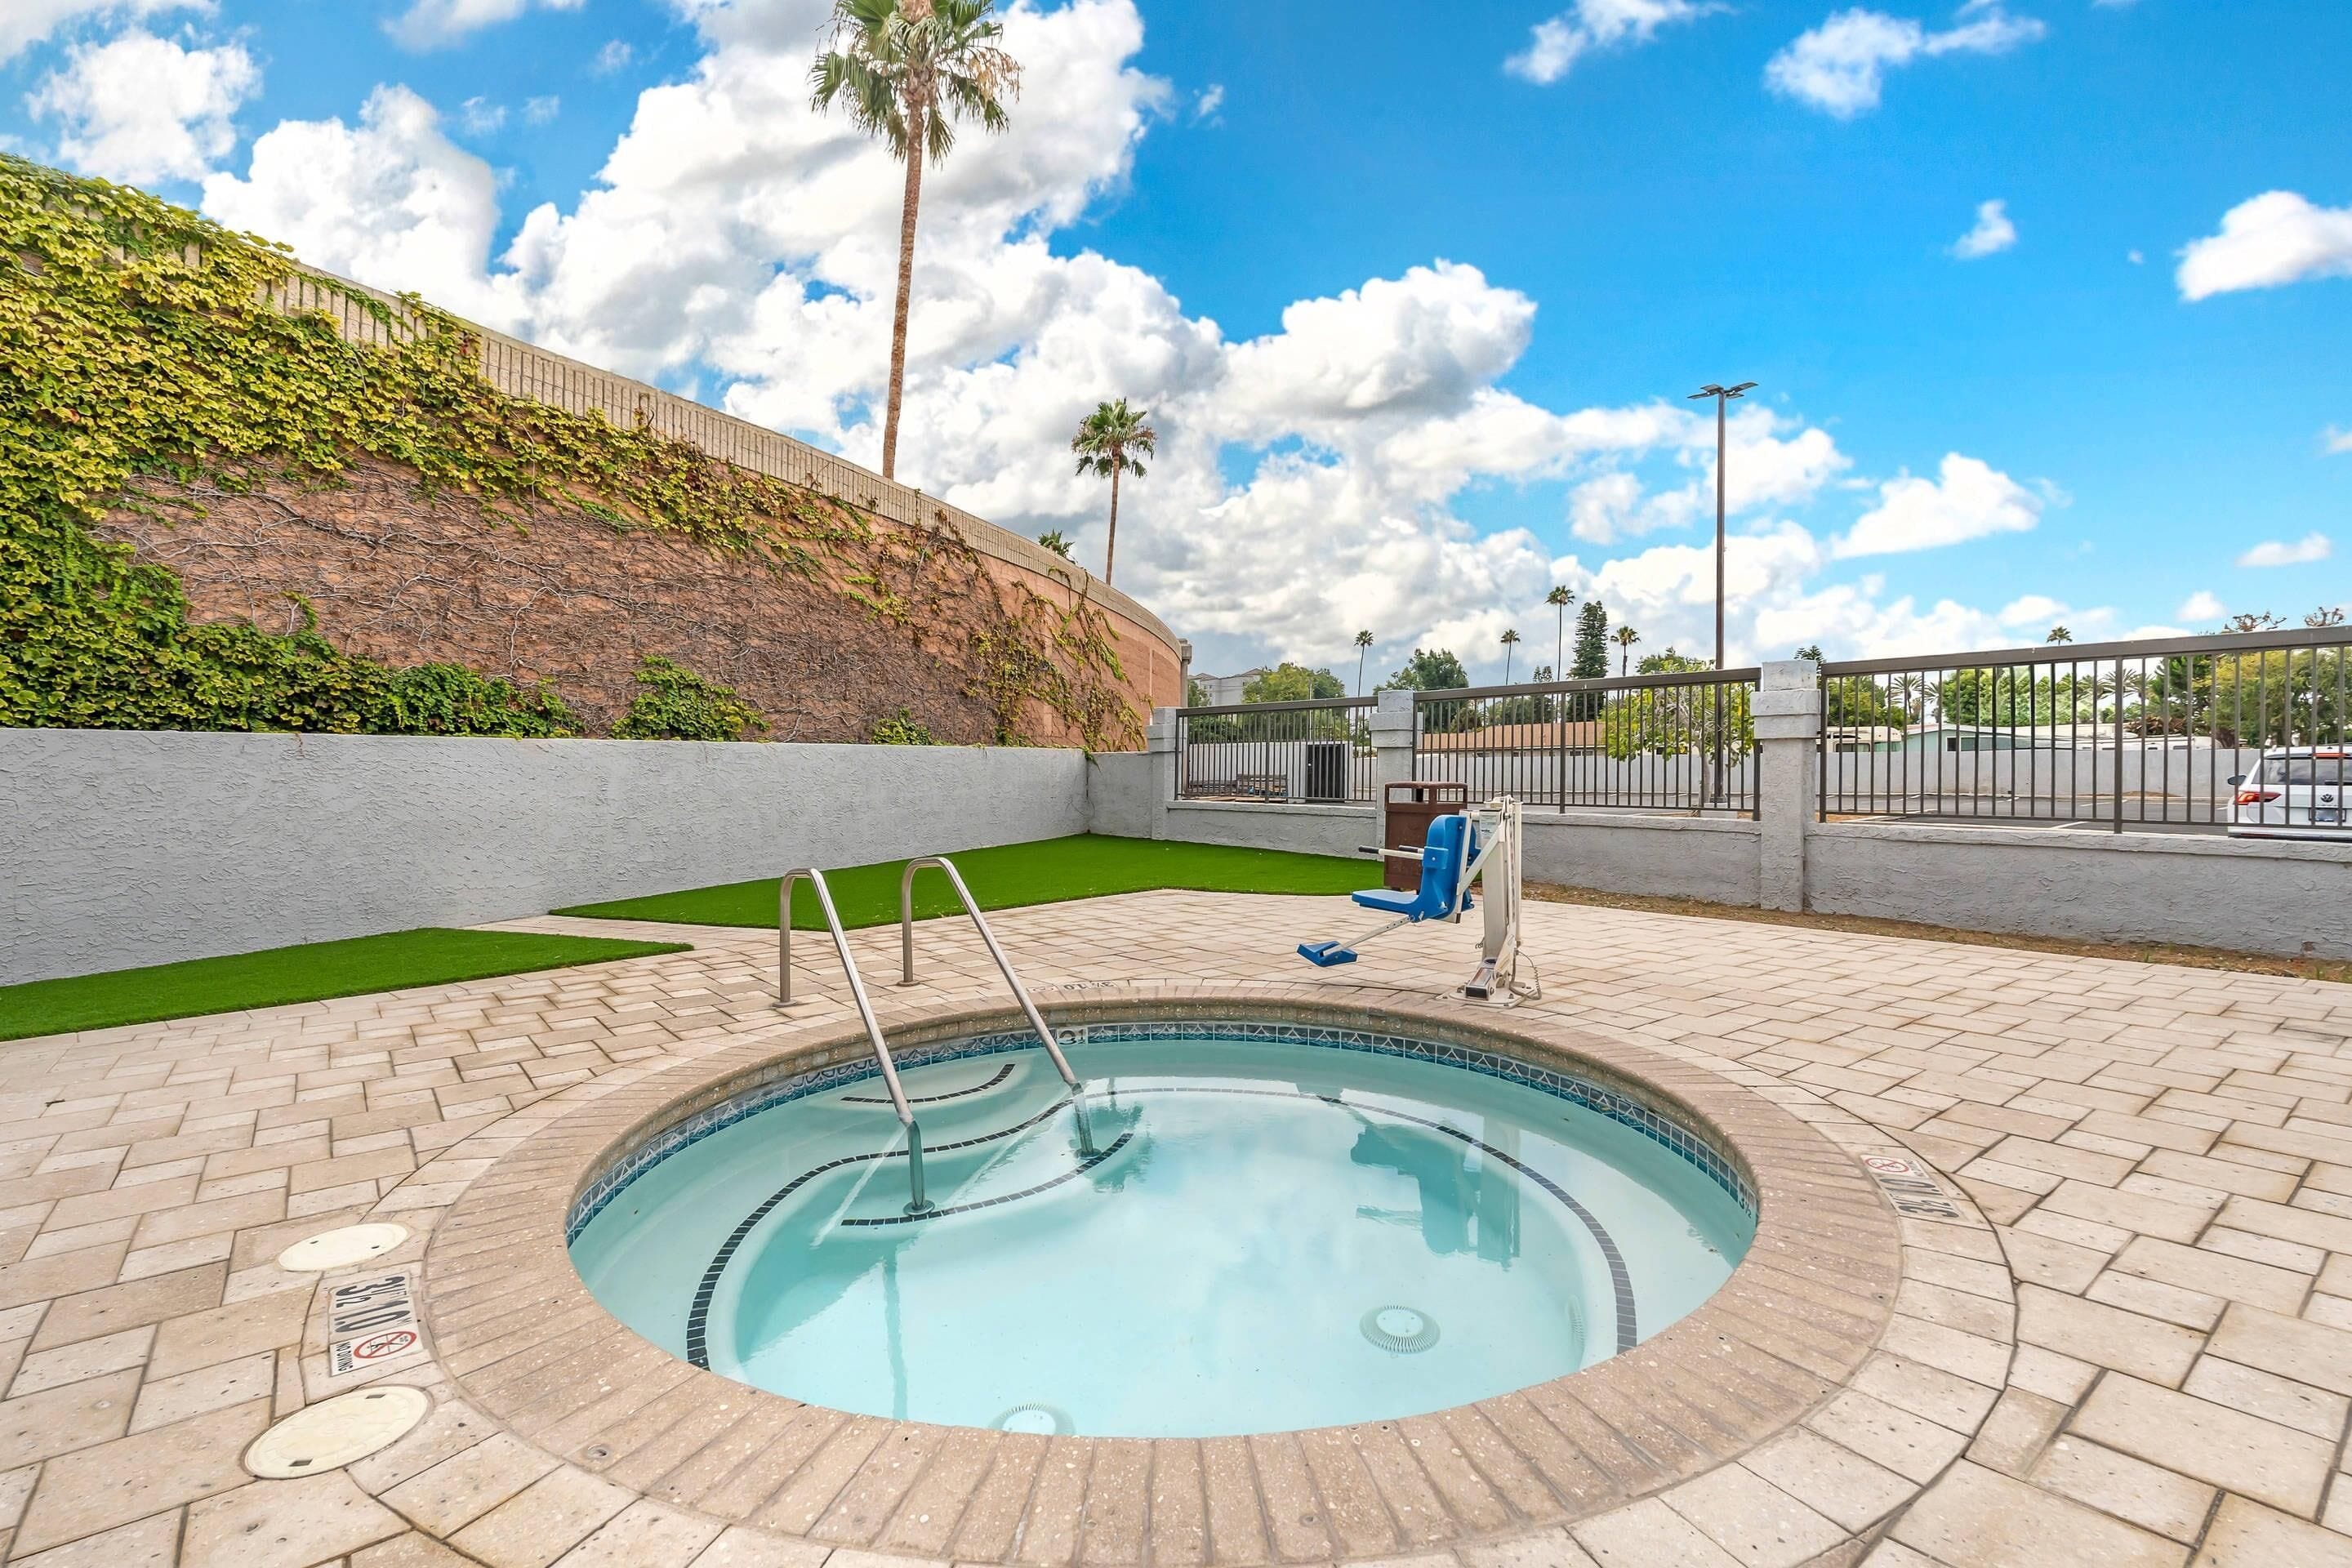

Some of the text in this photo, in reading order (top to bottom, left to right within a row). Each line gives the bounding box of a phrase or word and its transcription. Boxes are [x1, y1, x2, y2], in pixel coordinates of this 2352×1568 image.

[334, 1300, 411, 1333] 1.0
[336, 1341, 353, 1372] NO DIVING
